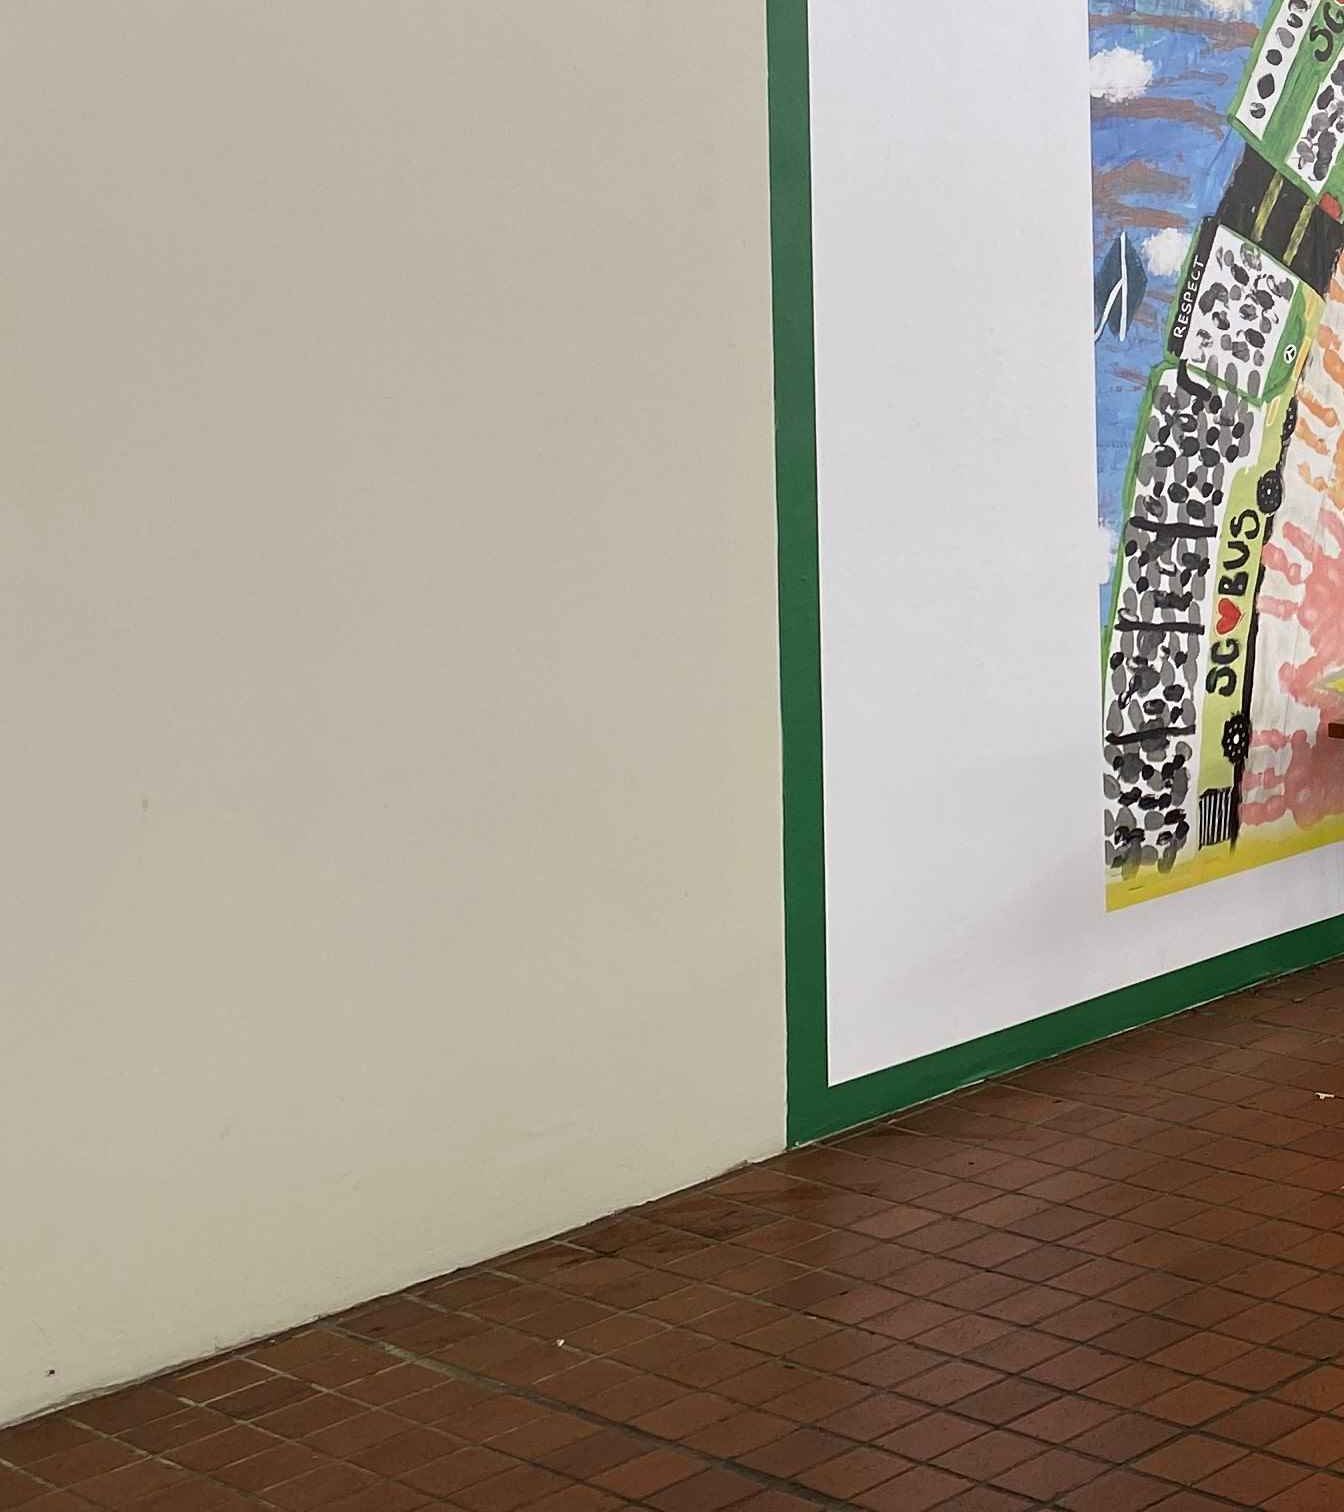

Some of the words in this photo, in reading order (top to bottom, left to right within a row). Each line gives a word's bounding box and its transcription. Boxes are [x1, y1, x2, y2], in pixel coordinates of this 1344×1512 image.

[1172, 258, 1204, 339] RESPECT
[1218, 509, 1261, 597] BUS
[1205, 636, 1240, 697] SG
